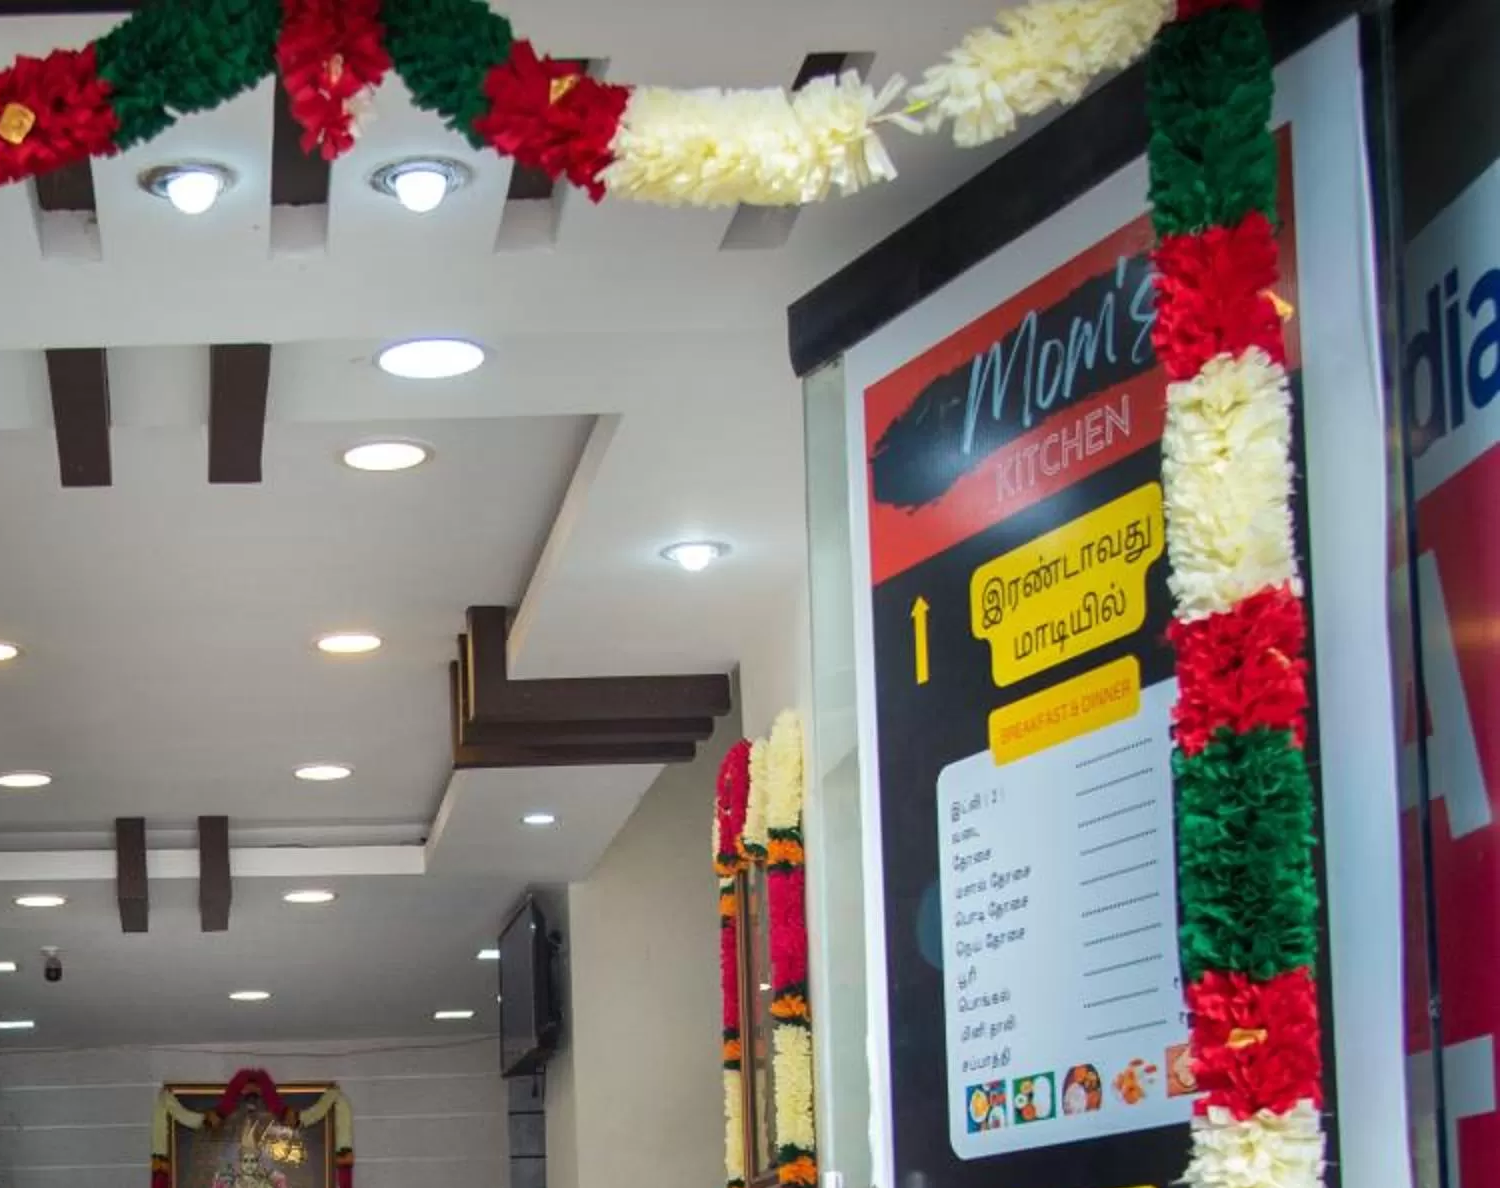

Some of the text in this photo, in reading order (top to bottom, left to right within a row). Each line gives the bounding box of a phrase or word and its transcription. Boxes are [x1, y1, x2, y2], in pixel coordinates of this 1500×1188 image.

[963, 256, 1162, 454] Mom's
[996, 394, 1131, 501] KITCHEN
[982, 515, 1152, 630] இரண்டாவது
[1013, 582, 1127, 660] மாடியில்
